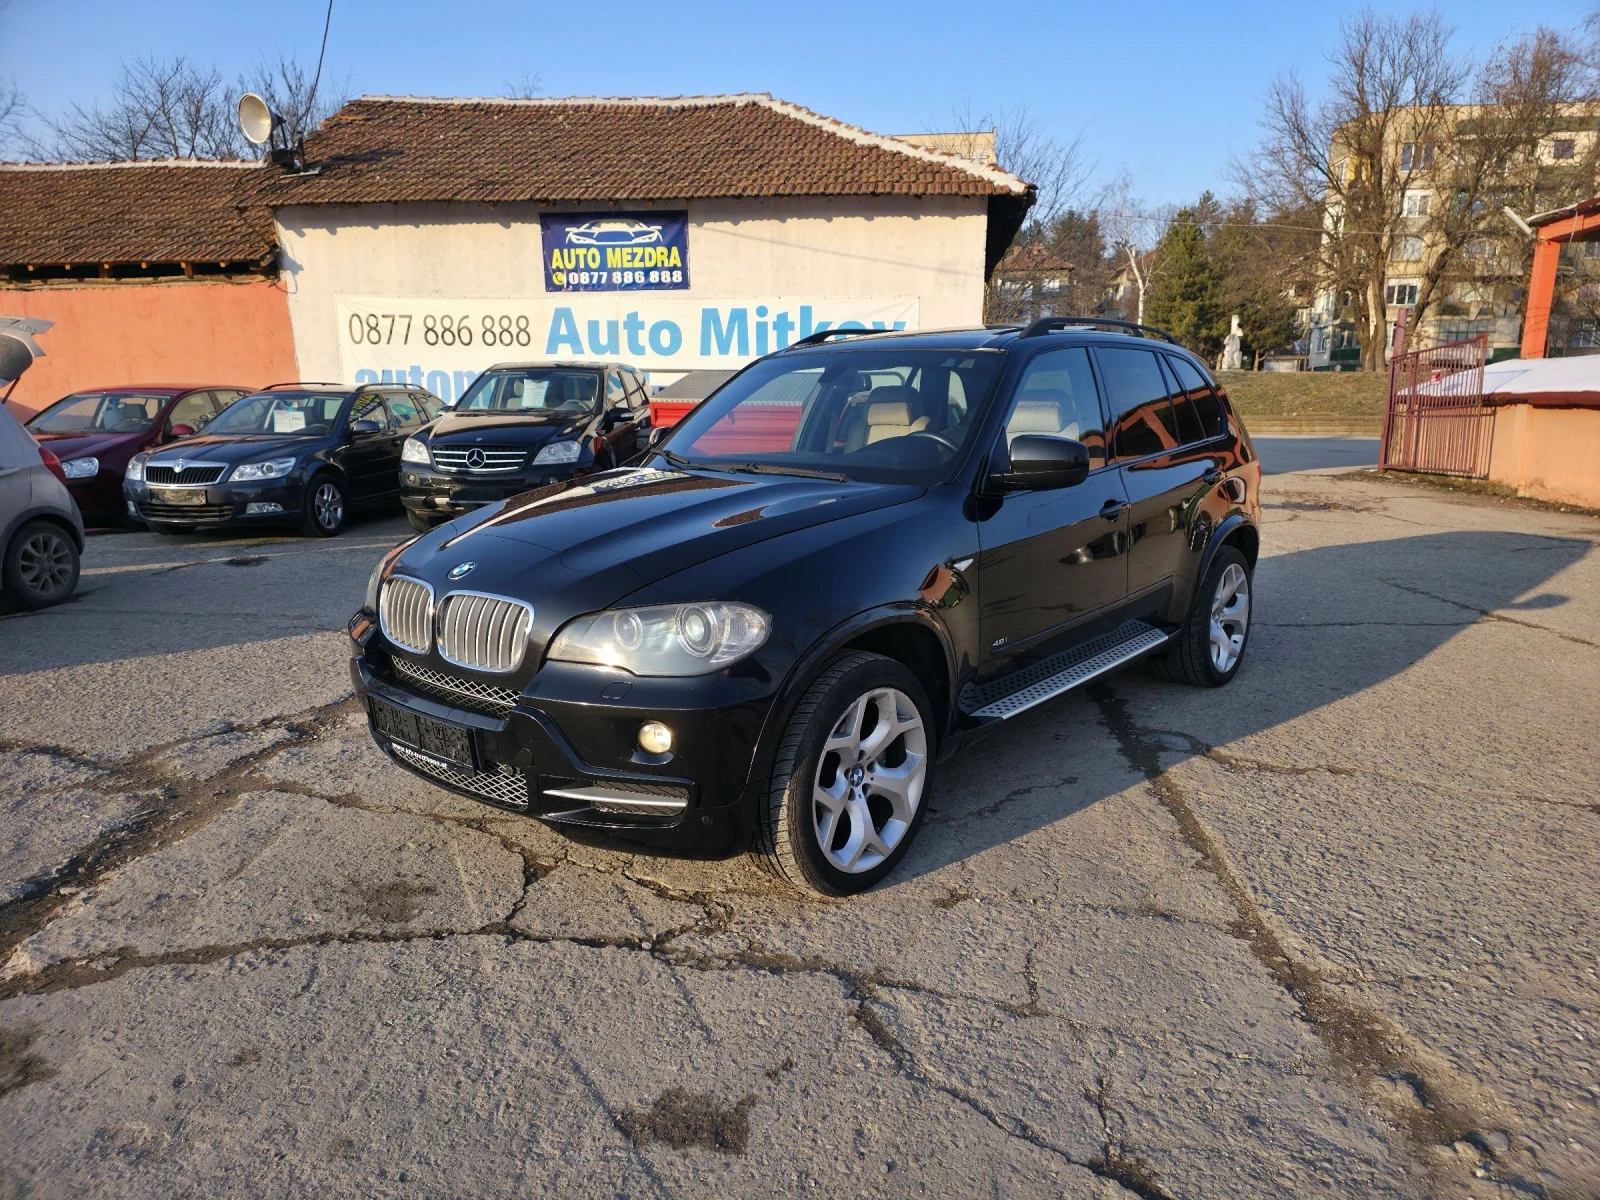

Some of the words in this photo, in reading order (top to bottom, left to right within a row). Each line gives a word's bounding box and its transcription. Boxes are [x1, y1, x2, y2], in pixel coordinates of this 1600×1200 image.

[551, 247, 601, 269] AUTO
[606, 246, 682, 269] MEZDRA
[568, 271, 608, 285] 0877
[612, 270, 645, 284] 886
[649, 270, 683, 284] 888
[349, 312, 413, 346] 0877
[423, 314, 473, 347] 886
[481, 314, 531, 347] 888
[545, 307, 683, 357] Auto
[700, 305, 907, 356] Mitk
